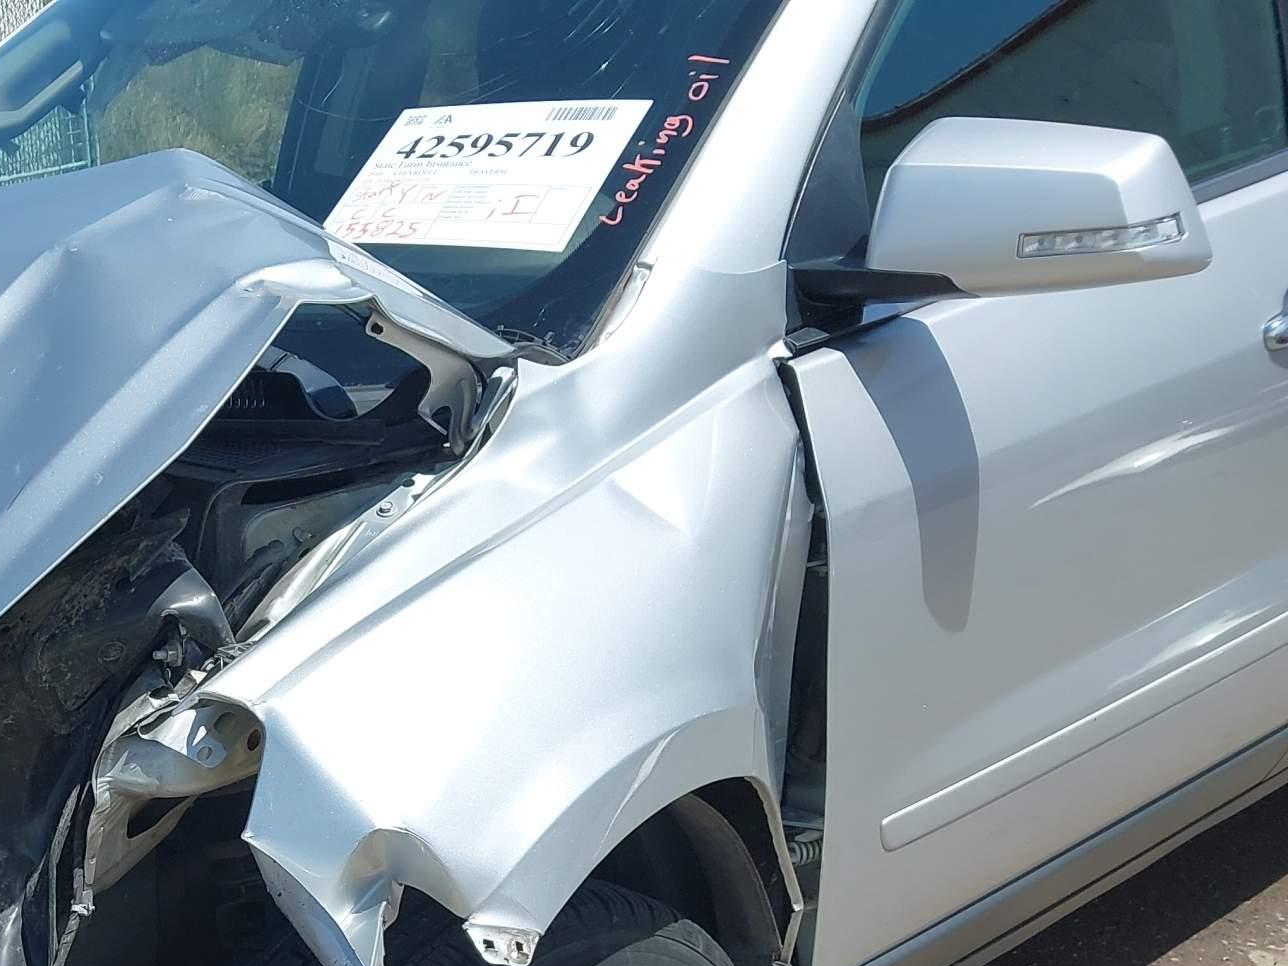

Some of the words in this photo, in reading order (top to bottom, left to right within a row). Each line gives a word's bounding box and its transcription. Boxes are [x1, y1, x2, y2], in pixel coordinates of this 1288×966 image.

[688, 55, 730, 101] oil
[396, 131, 595, 160] 42595719
[374, 160, 395, 169] State
[397, 160, 424, 169] Farm
[425, 159, 473, 168] Insurance
